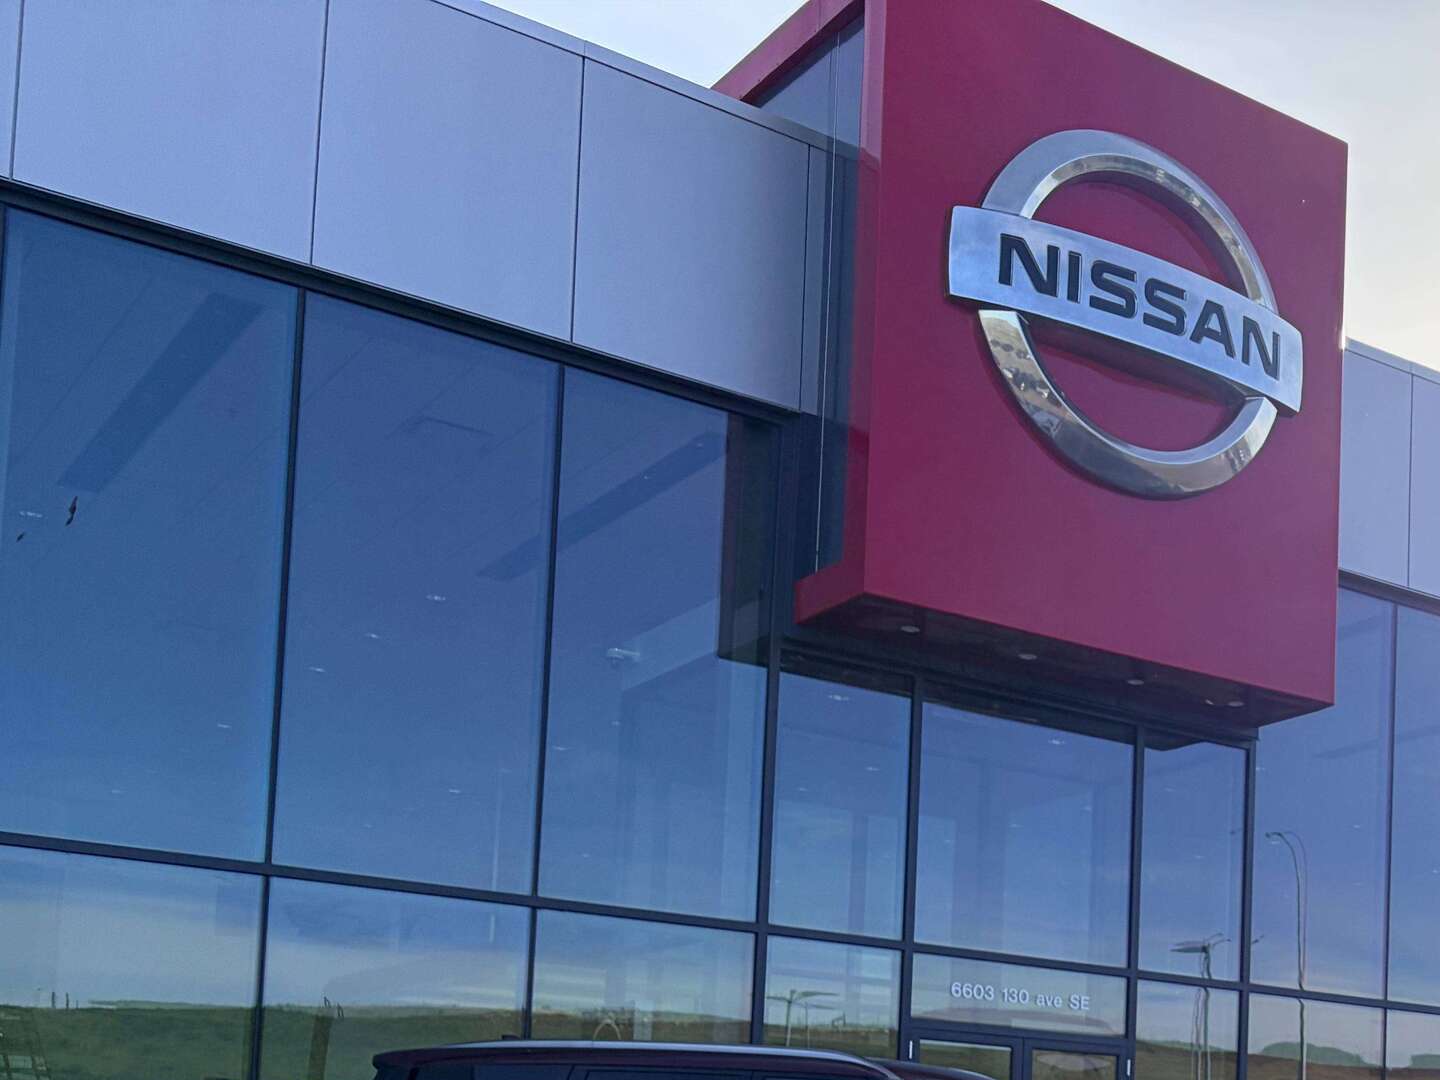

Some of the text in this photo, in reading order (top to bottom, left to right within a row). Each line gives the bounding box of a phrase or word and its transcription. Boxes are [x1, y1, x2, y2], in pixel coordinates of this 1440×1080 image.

[998, 232, 1281, 381] NISSAN
[951, 982, 1089, 1010] 6603 130 ave SE
